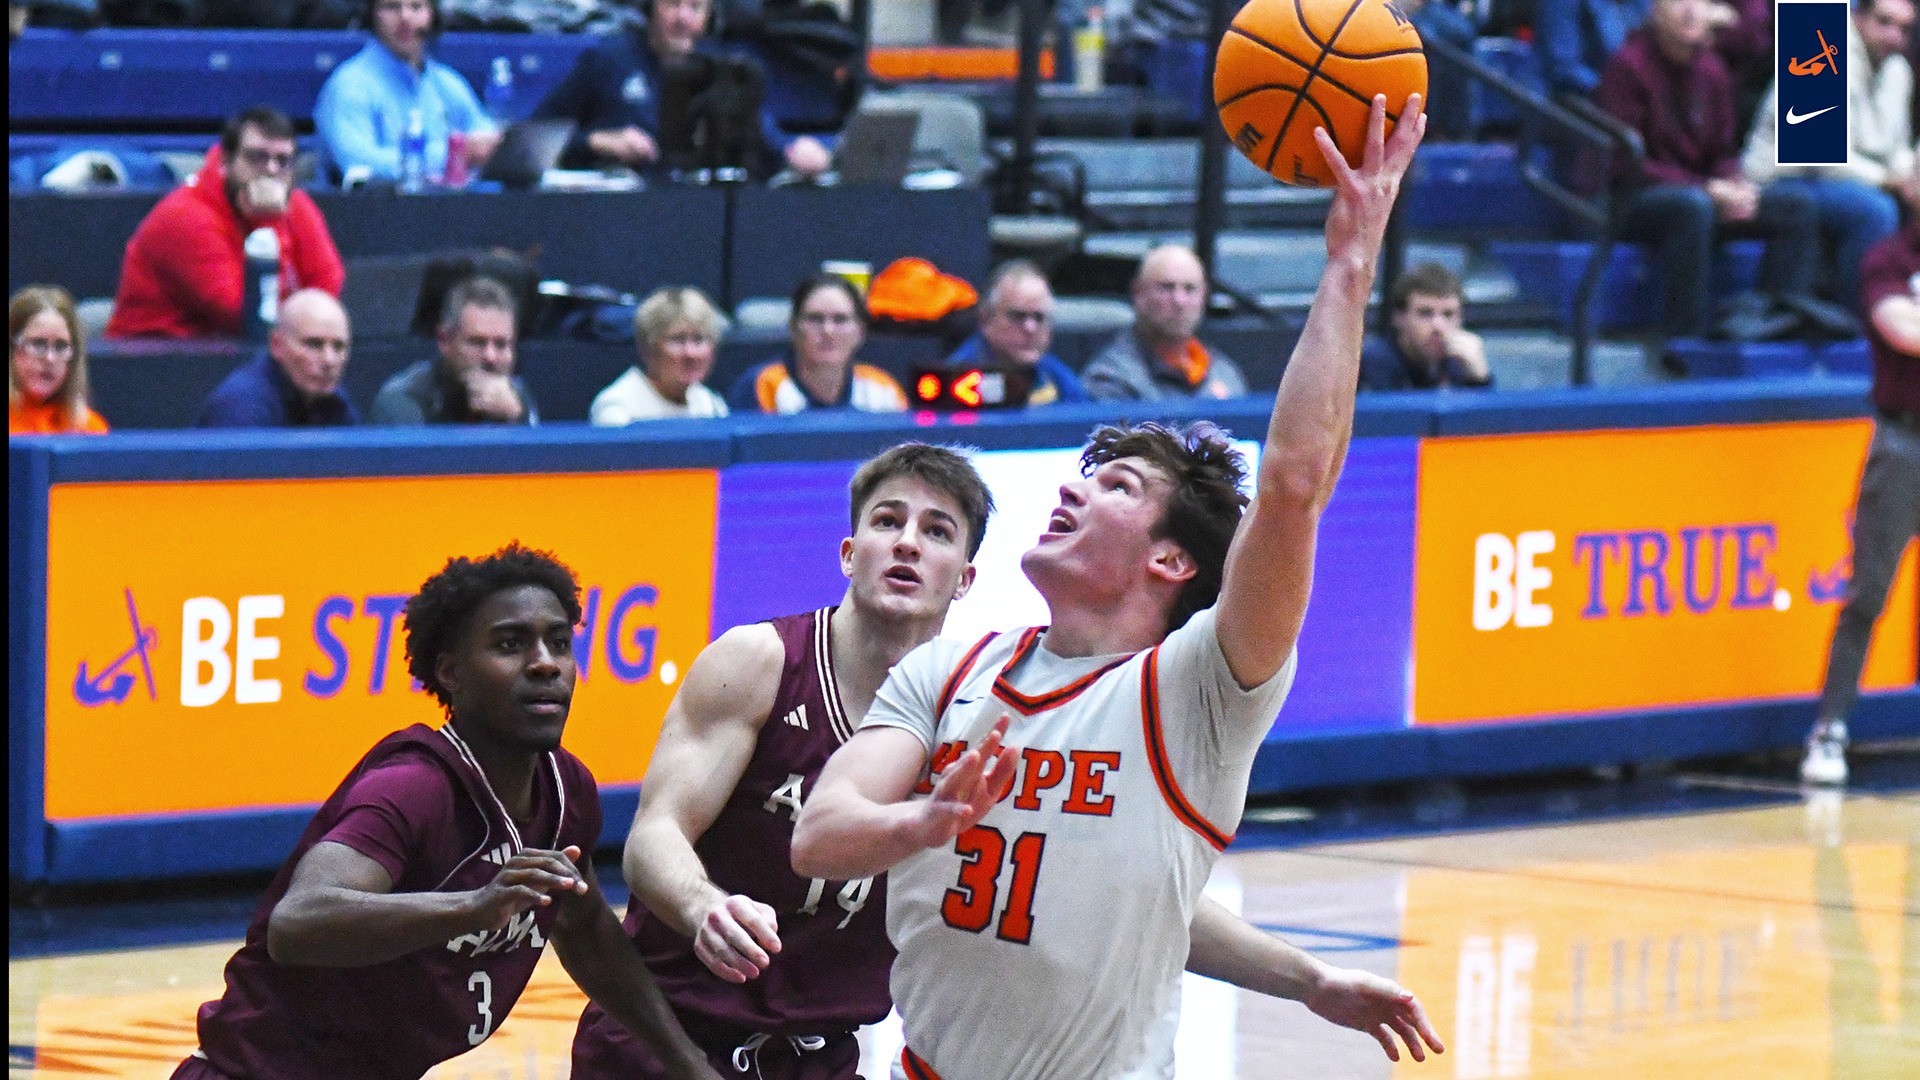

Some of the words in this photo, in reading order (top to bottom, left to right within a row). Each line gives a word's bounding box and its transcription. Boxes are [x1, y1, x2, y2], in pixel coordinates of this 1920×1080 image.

[1472, 530, 1556, 631] BE
[1572, 520, 1792, 621] TRUE.
[180, 594, 285, 707] BE
[303, 583, 678, 699] STNG.
[940, 823, 1047, 945] 31
[467, 970, 493, 1046] 3
